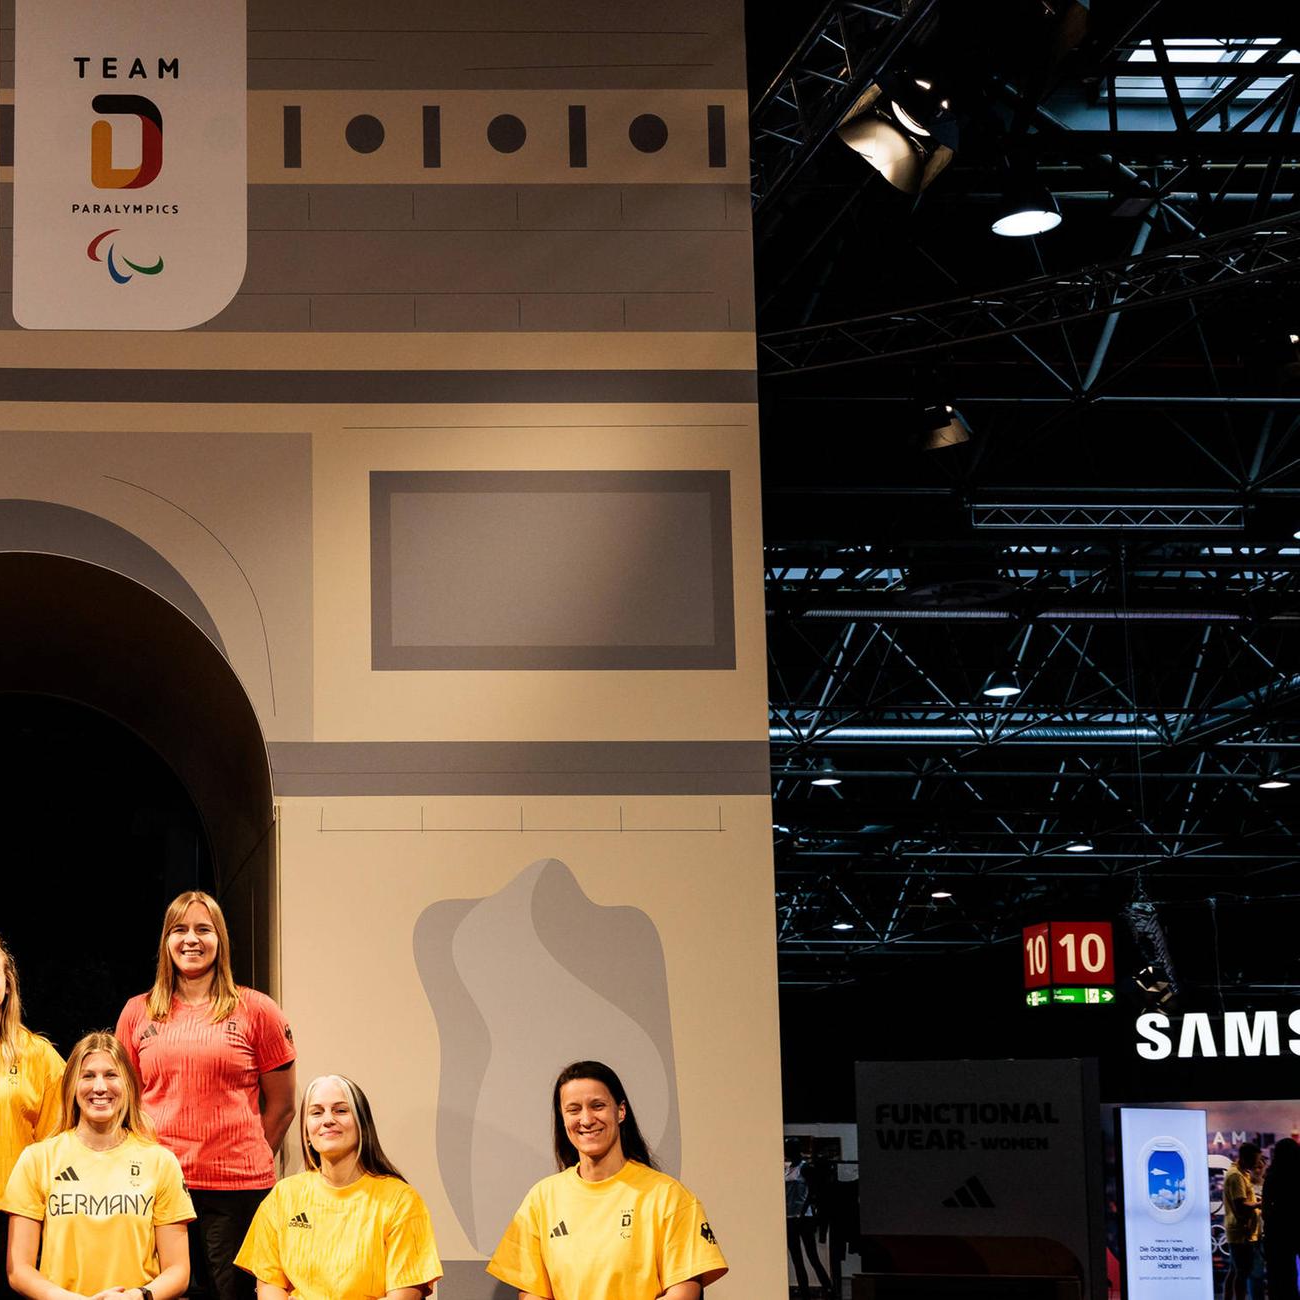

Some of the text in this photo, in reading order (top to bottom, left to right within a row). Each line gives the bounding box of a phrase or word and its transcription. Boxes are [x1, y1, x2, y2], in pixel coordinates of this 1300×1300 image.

[73, 57, 181, 80] TEAM
[71, 203, 181, 215] PARALYMPICS
[1026, 935, 1047, 976] 10
[1058, 933, 1106, 973] 10
[875, 1102, 1060, 1125] FUNCTIONAL
[875, 1129, 967, 1150] WEAR
[980, 1137, 1049, 1150] WOMEN
[49, 1193, 154, 1217] GERMANY
[288, 1222, 313, 1230] adidas
